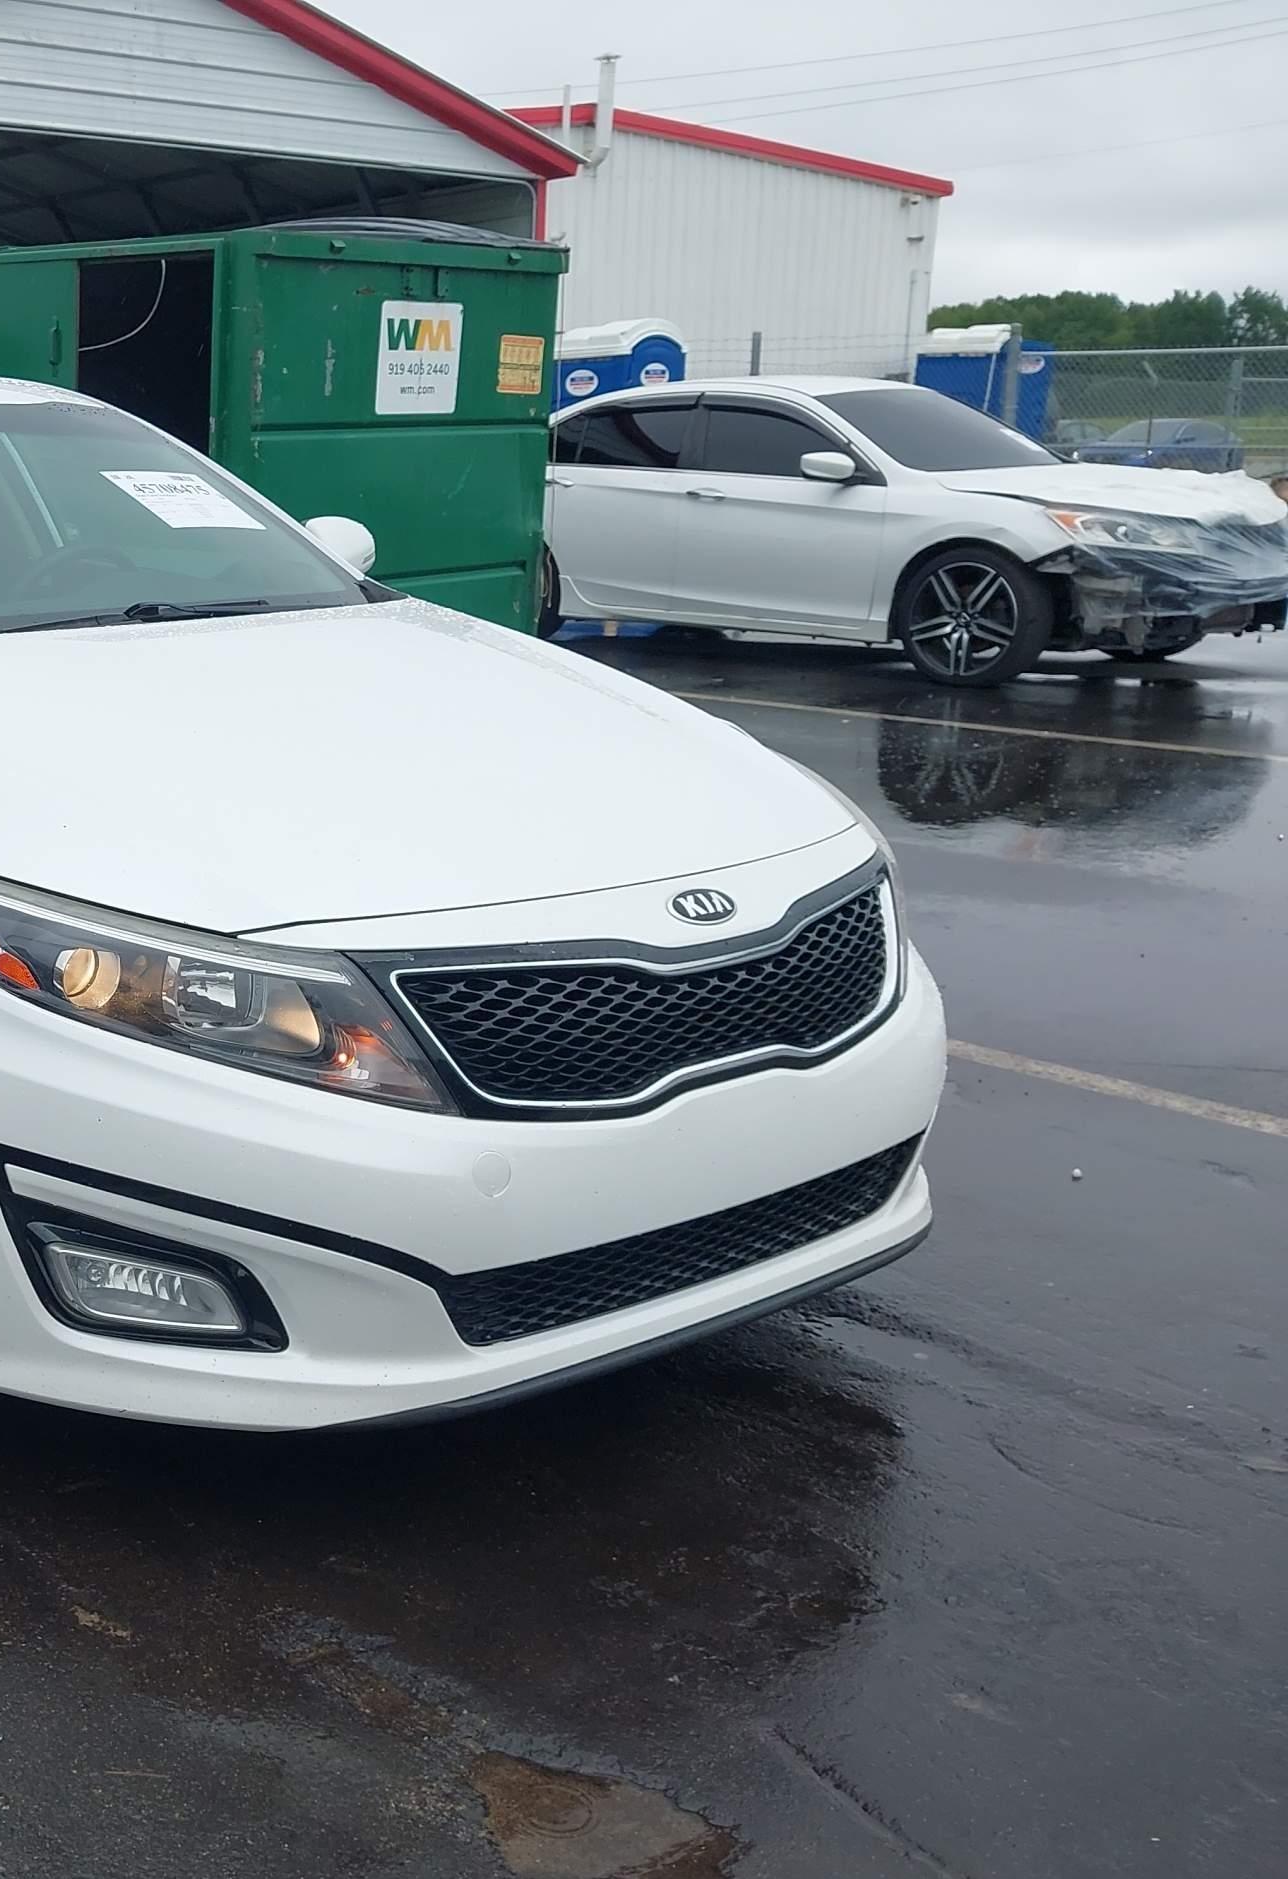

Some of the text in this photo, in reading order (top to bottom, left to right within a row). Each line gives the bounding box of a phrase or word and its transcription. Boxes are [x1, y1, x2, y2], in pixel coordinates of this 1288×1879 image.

[387, 318, 453, 351] WM
[388, 363, 405, 376] 919
[426, 363, 450, 376] 2440
[400, 385, 435, 395] wm.com
[676, 891, 733, 918] KIA
